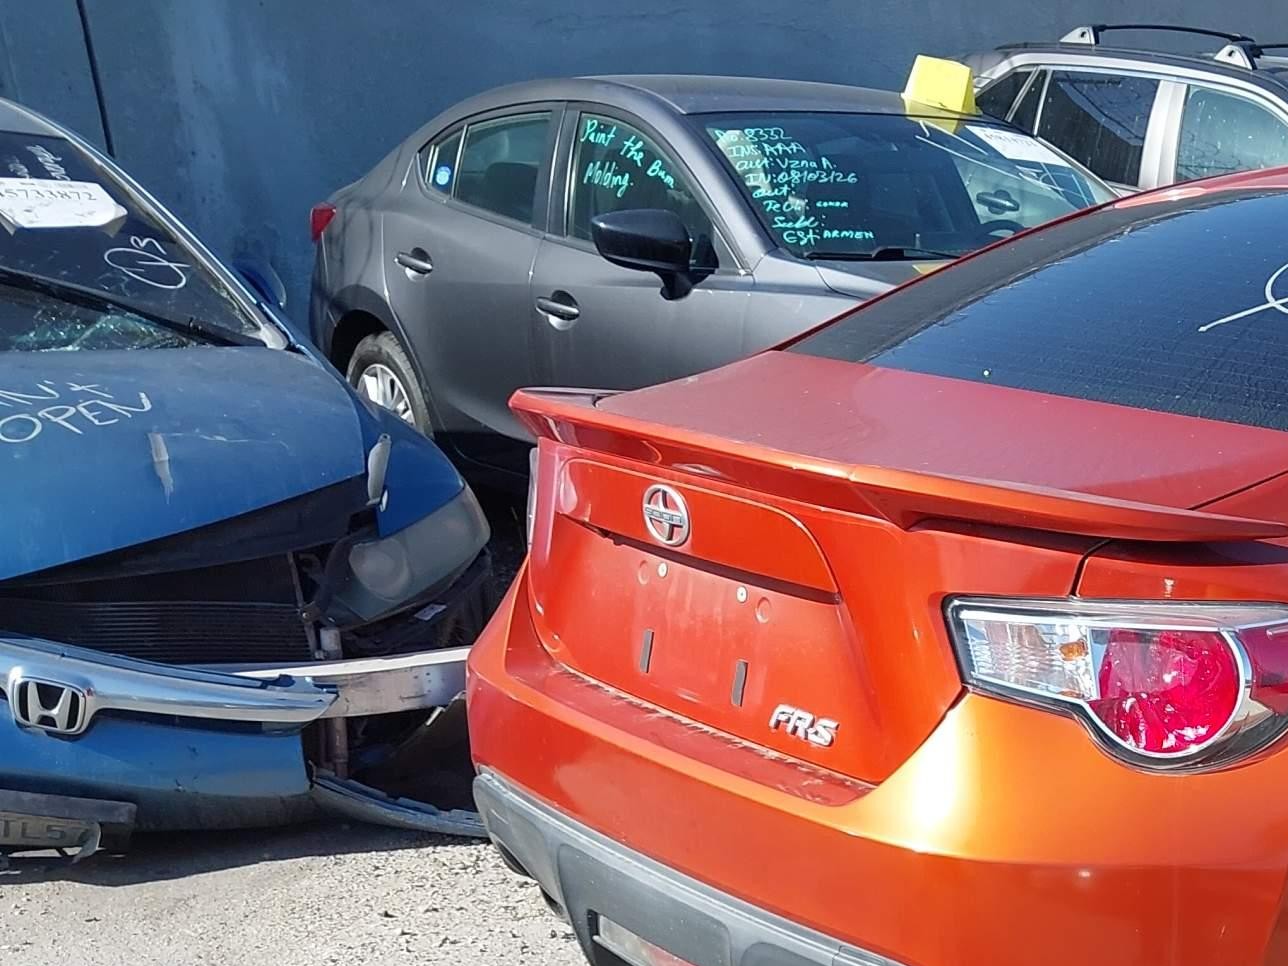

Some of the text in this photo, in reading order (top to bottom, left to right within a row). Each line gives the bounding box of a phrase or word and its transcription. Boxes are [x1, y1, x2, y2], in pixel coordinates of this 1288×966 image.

[580, 119, 616, 146] Paint
[620, 135, 644, 167] the
[0, 391, 152, 442] OPEN
